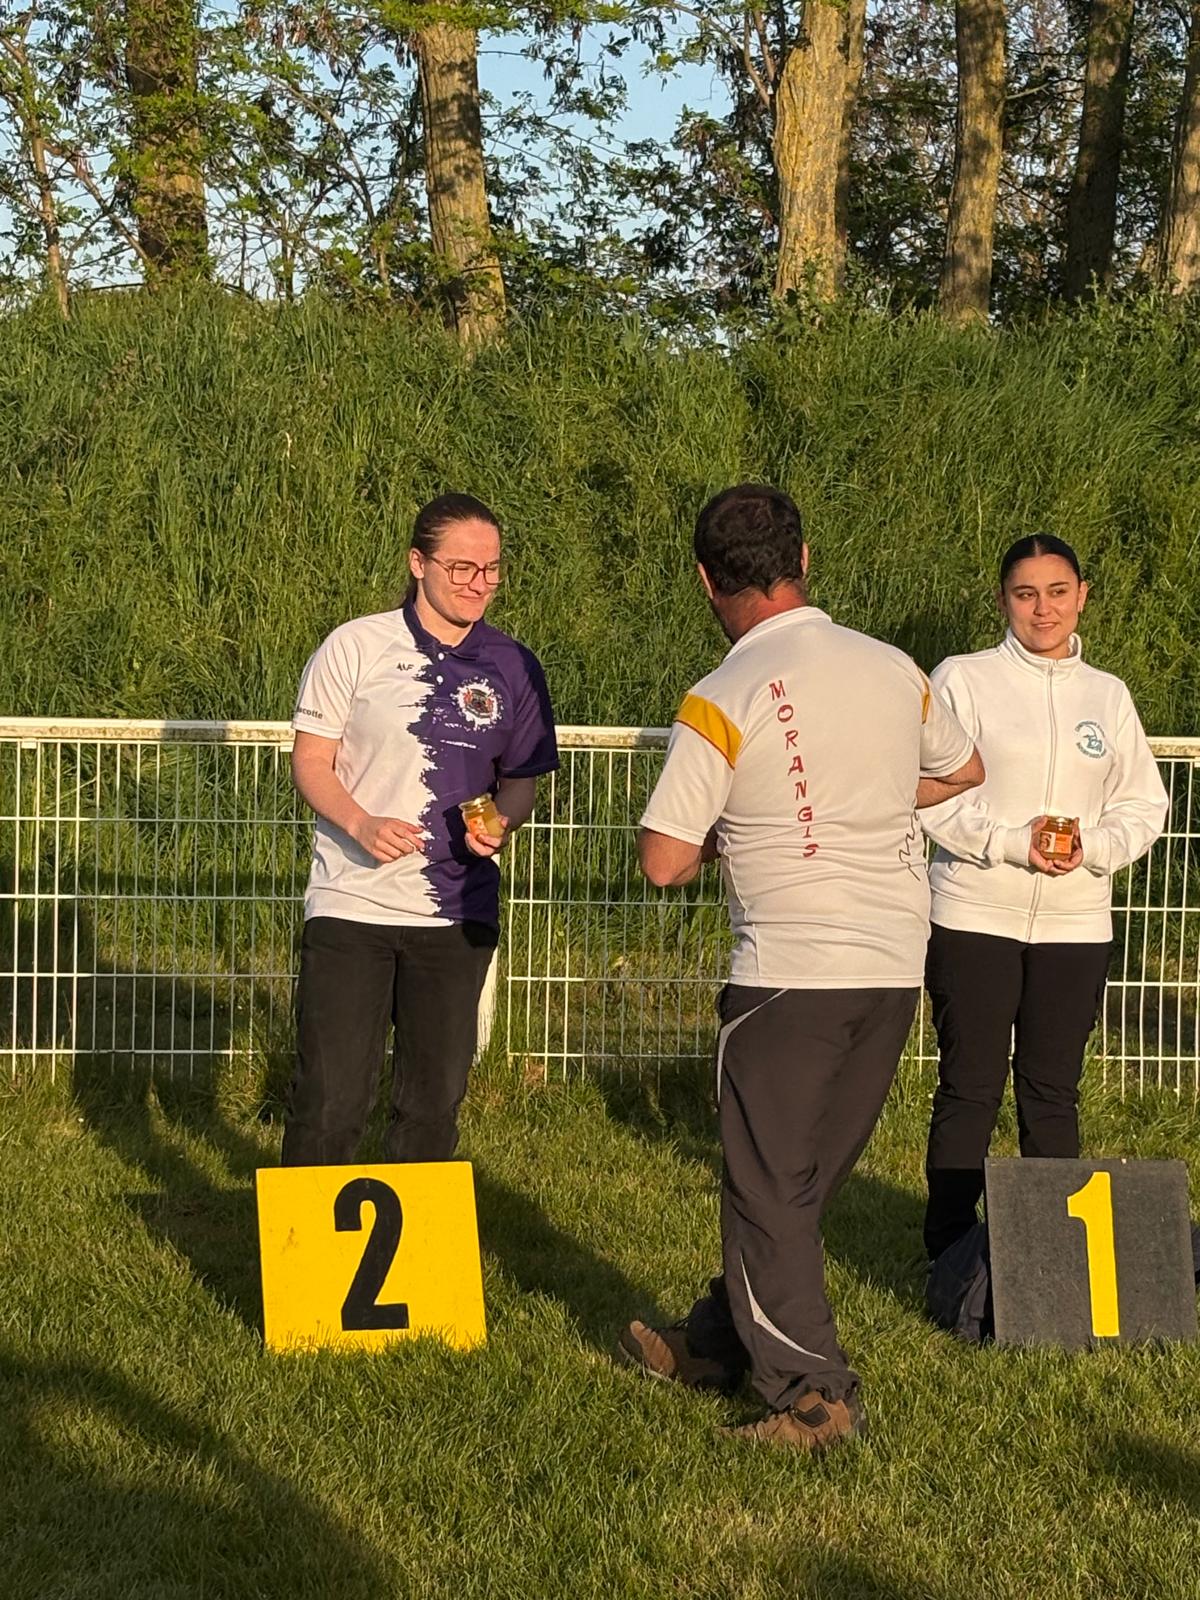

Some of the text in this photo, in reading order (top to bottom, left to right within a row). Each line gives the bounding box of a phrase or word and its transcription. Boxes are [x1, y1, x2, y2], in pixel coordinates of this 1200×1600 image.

[768, 679, 820, 858] MORANGIS
[334, 1178, 408, 1331] 2
[1066, 1170, 1121, 1339] 1
